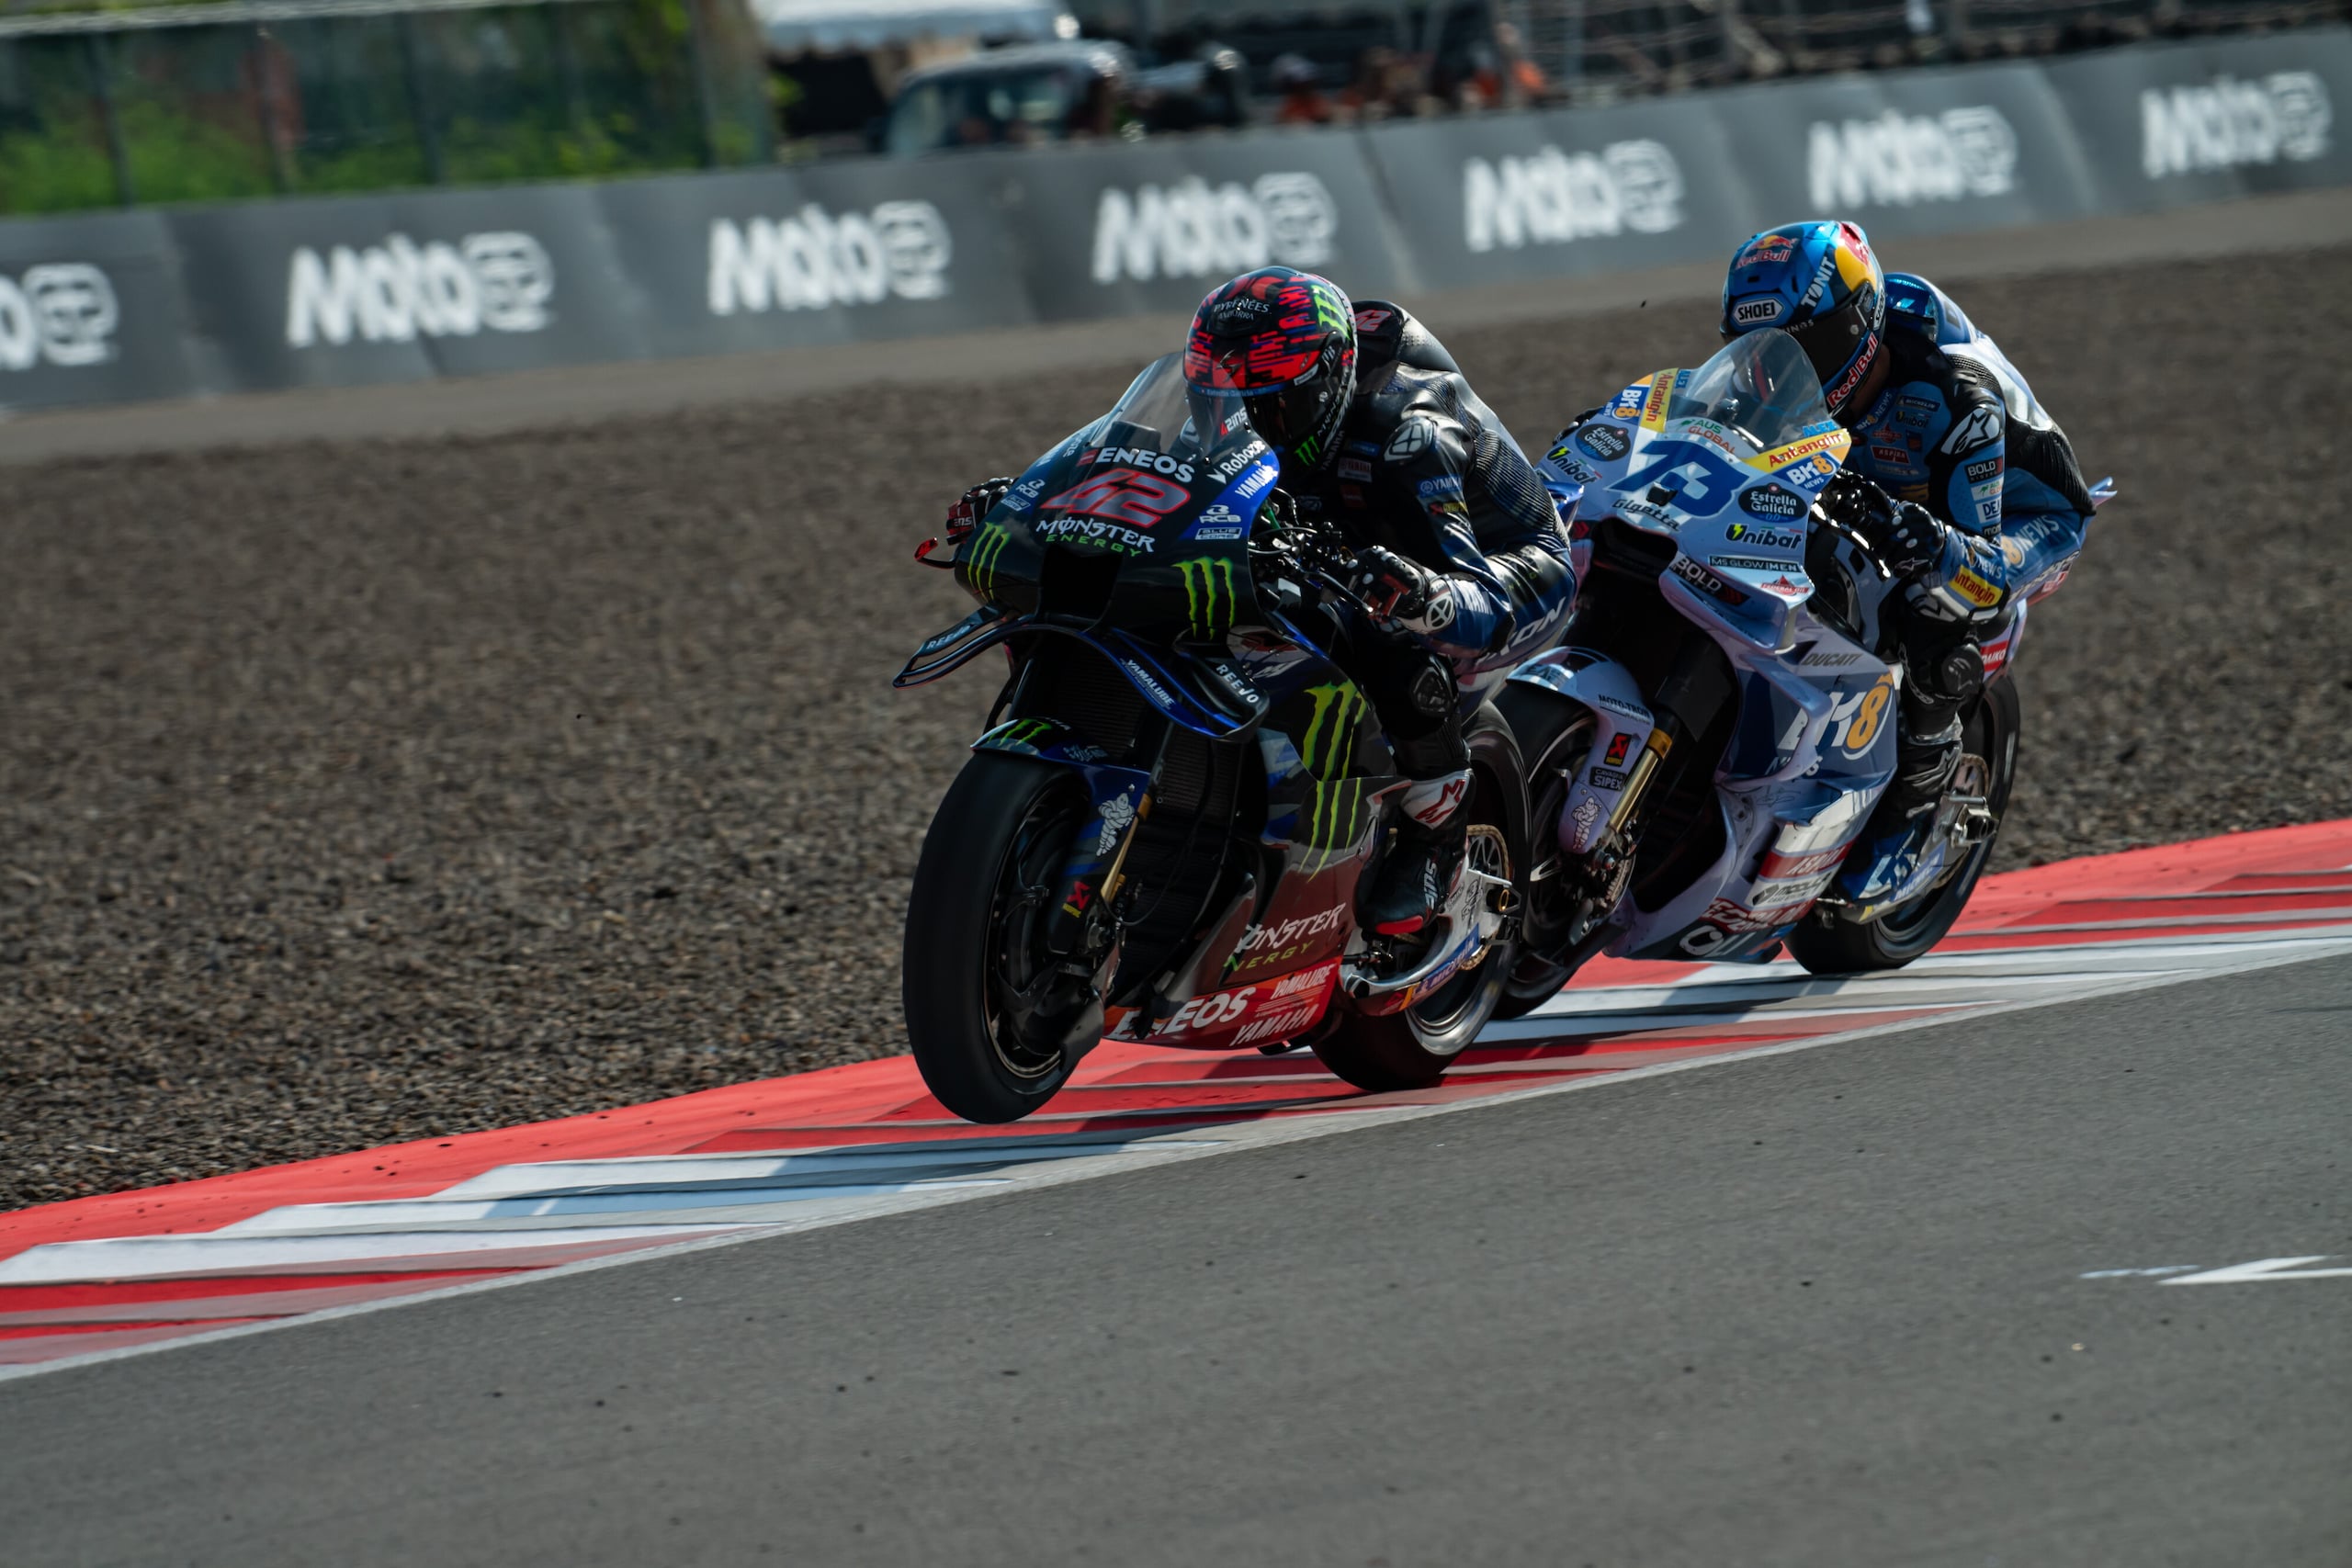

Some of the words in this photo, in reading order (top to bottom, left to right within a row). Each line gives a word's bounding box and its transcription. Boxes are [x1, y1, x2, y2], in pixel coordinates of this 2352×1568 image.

[1760, 249, 1792, 264] Bull
[1737, 301, 1776, 321] SHOEI
[1826, 367, 1861, 409] Red
[1856, 332, 1879, 376] Bull
[1616, 389, 1642, 419] BK8
[1646, 373, 1674, 422] Antangin
[1874, 391, 1894, 417] NEWS
[1592, 426, 1625, 452] Estrella
[1694, 419, 1723, 434] AUS
[1584, 434, 1613, 457] Galicia
[1688, 425, 1736, 455] GLOBAL
[1768, 433, 1843, 467] Antangin
[1096, 446, 1194, 483] ENEOS
[1547, 446, 1597, 485] Unibat
[1786, 454, 1836, 485] BK8
[1968, 461, 1996, 477] BOLD
[1608, 440, 1750, 516] 73
[1039, 468, 1192, 529] 42
[1750, 491, 1796, 506] Estrella
[1751, 501, 1794, 514] Galicia
[1198, 514, 1242, 525] RCB
[1045, 534, 1142, 558] ENERGY
[1725, 524, 1802, 549] Unibat
[1677, 556, 1723, 592] BOLD
[1711, 557, 1728, 567] MS
[1729, 558, 1764, 569] GLOW
[1801, 653, 1862, 666] DUCATI
[1125, 659, 1177, 707] YAMALUBE
[1593, 775, 1623, 790] SIPEX
[1229, 1003, 1317, 1047] YAMAHA
